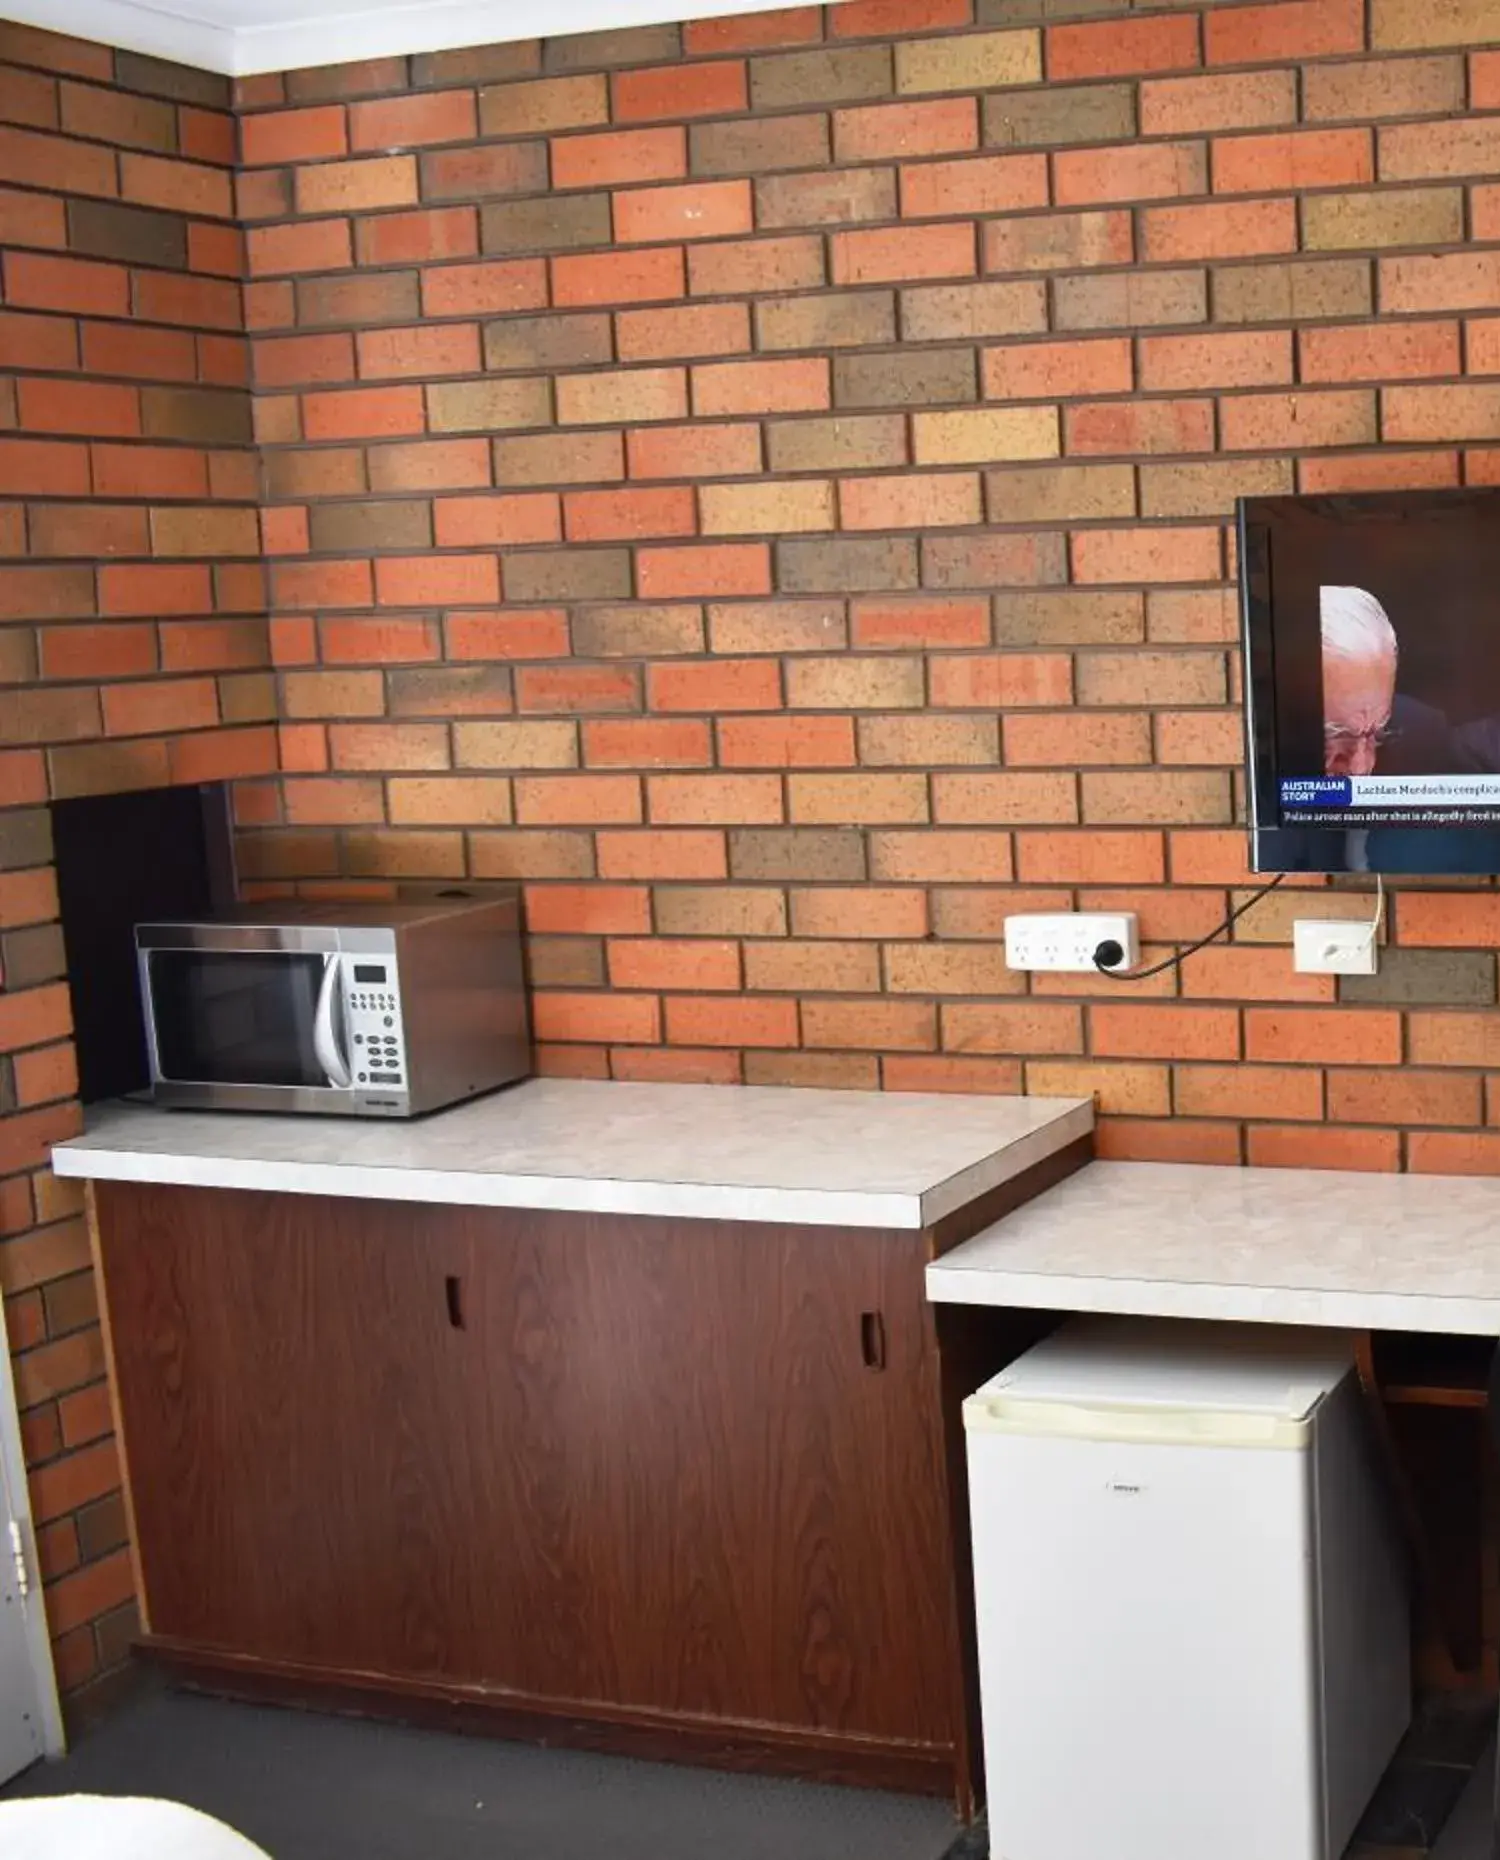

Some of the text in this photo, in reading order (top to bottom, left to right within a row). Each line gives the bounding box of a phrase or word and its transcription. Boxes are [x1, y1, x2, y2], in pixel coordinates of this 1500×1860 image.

[1281, 781, 1345, 791] AUSTRALIAN
[1357, 784, 1397, 794] Lachlan
[1399, 784, 1451, 794] Murdoch's
[1281, 791, 1317, 801] STORY
[1284, 811, 1312, 821] Police
[1314, 812, 1342, 821] arrest
[1344, 813, 1365, 821] man
[1366, 811, 1388, 821] after
[1390, 811, 1410, 821] shot
[1422, 811, 1464, 823] allegedly
[1466, 811, 1490, 821] fired
